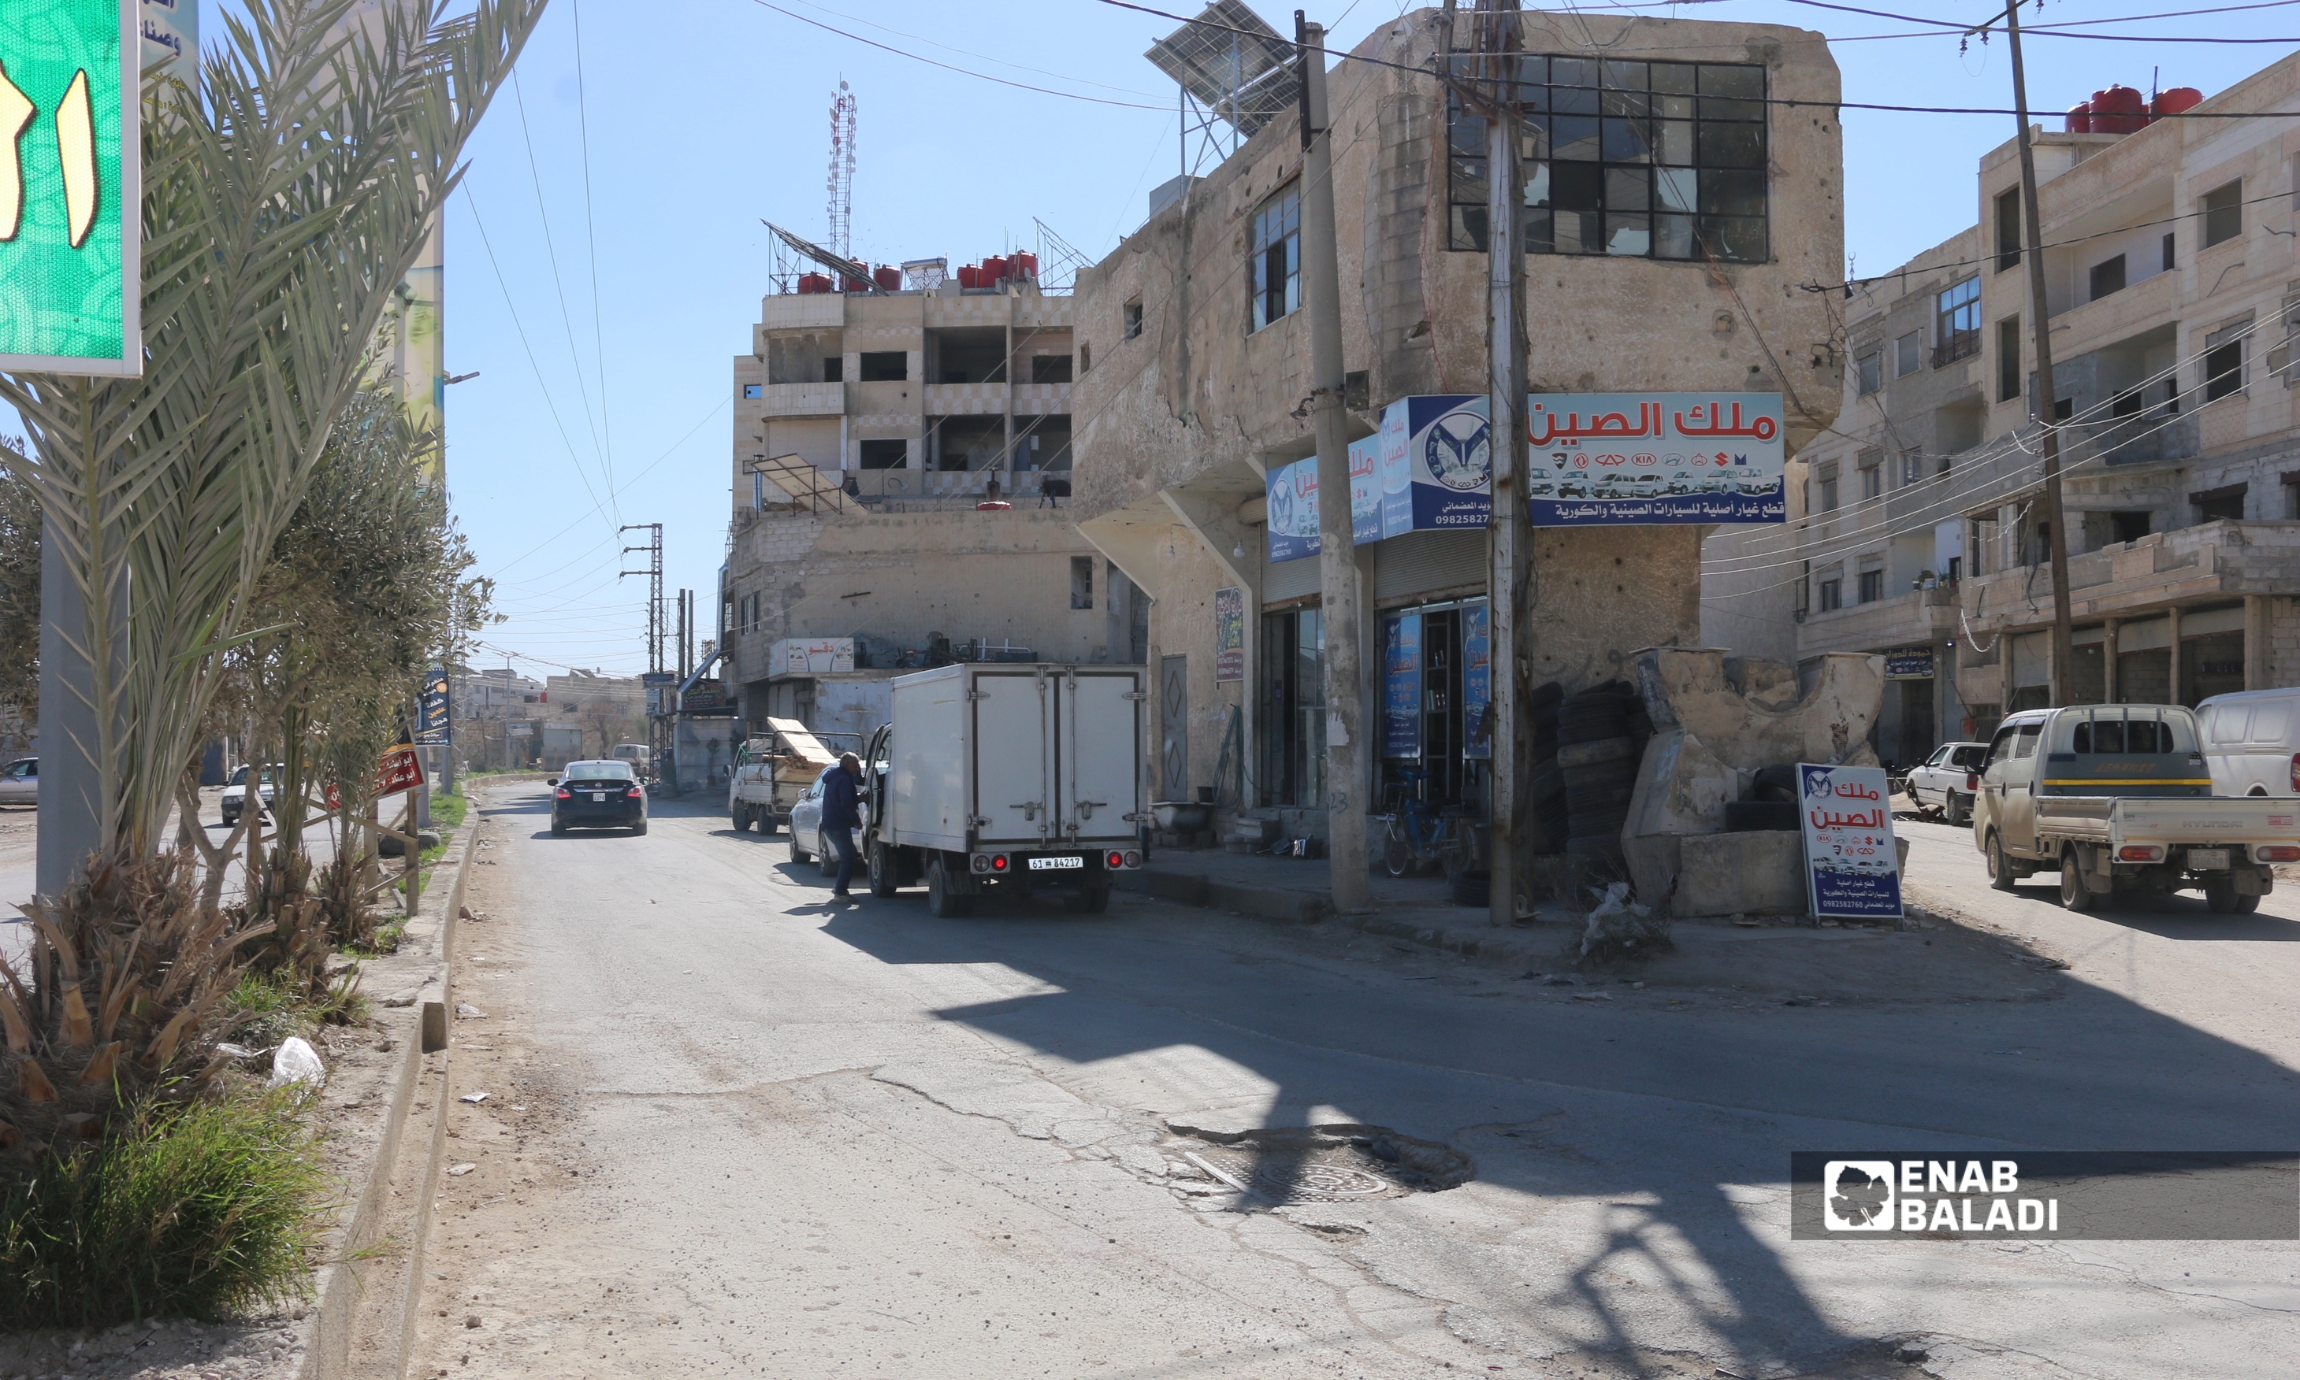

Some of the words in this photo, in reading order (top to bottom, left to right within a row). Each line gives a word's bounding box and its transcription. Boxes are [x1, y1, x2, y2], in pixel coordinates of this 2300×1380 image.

[1391, 419, 1405, 434] ملك
[1528, 402, 1662, 446] الصين
[1674, 402, 1777, 441] ملك
[1634, 455, 1654, 465] KIA
[1442, 501, 1477, 513] المعضماني
[1556, 503, 1608, 519] والكورية
[1609, 503, 1652, 517] الصينية
[1654, 502, 1701, 517] للسيارات
[1703, 501, 1734, 515] أصلية
[1736, 502, 1760, 518] غيار
[1762, 501, 1784, 518] قطع
[1435, 514, 1490, 525] 09825827
[1835, 783, 1879, 801] ملك
[1811, 806, 1884, 830] الصين
[1032, 859, 1043, 869] 61
[1053, 857, 1080, 868] 84217
[1852, 879, 1863, 888] غيار
[1864, 879, 1875, 888] قطع
[1823, 888, 1848, 897] والكورية
[1848, 888, 1868, 897] الصينية
[1868, 889, 1889, 898] للسيارات
[1823, 900, 1864, 908] 0982582760
